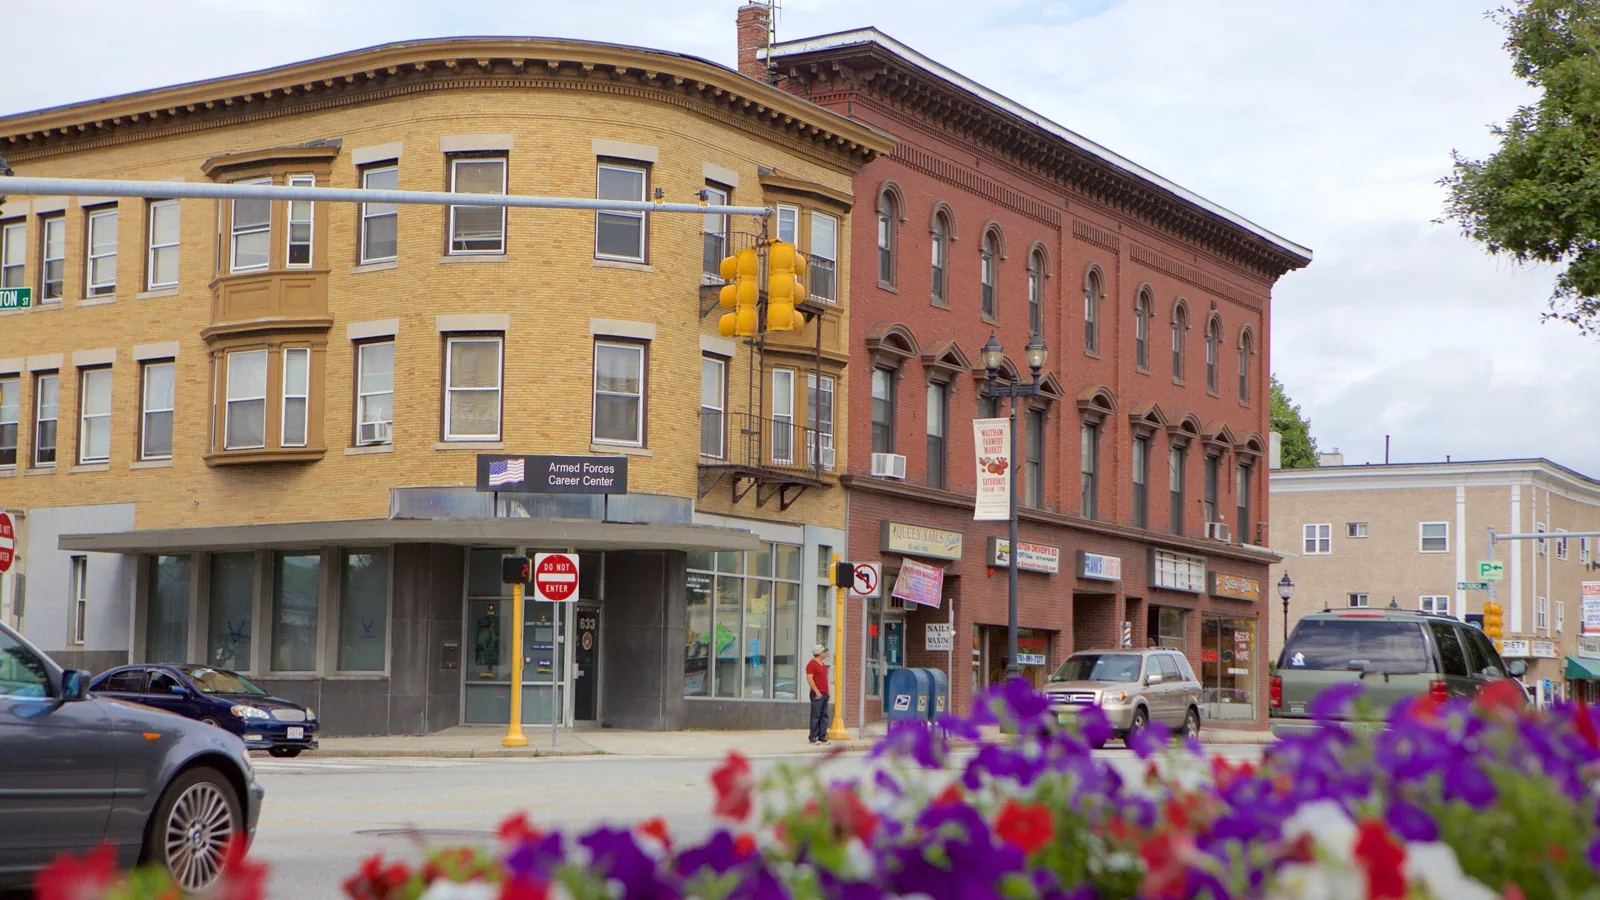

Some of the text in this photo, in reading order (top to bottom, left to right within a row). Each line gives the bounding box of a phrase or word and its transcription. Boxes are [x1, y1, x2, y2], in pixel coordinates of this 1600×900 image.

[0, 290, 30, 307] TON ST
[981, 428, 1004, 437] WALTHAM
[982, 437, 1003, 446] FARMERS
[983, 445, 1003, 454] MARKET
[548, 462, 615, 474] Armed Forces
[548, 475, 614, 487] Career Center
[982, 477, 1006, 486] SATURDAYS
[896, 525, 921, 541] QUEEN
[923, 529, 945, 544] NAILS
[544, 563, 570, 572] DO NOT
[545, 584, 569, 593] ENTER
[579, 618, 596, 630] 633
[927, 625, 950, 633] NAILS
